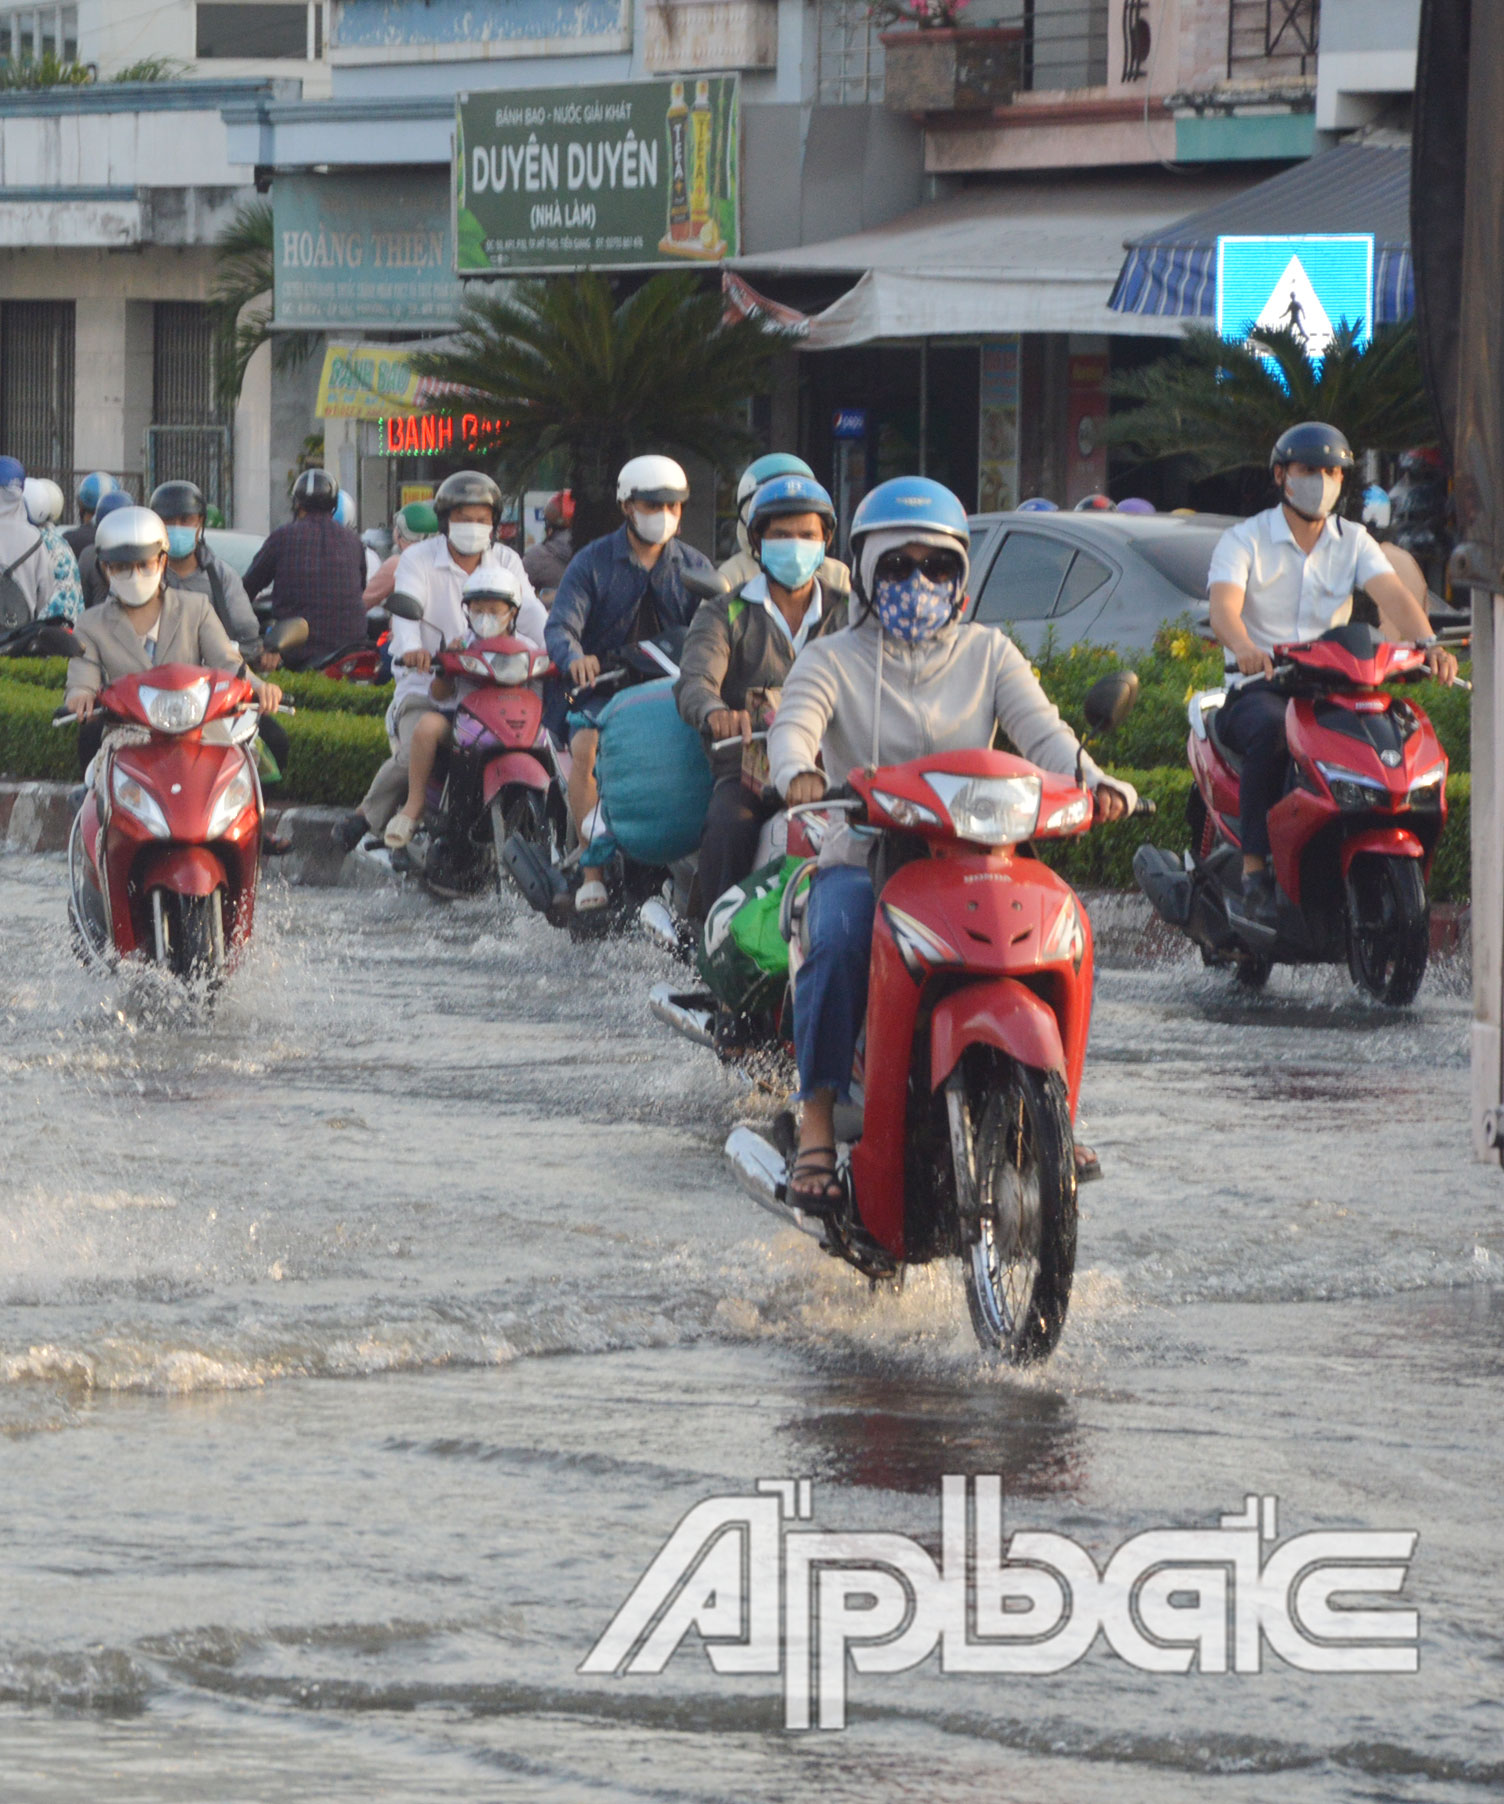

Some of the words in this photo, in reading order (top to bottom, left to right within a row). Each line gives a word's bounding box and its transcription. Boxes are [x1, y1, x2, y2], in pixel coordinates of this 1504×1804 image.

[496, 105, 523, 128] BÁNH
[524, 106, 546, 125] BAO
[553, 101, 583, 125] NƯỚC
[583, 99, 604, 123] GIẢI
[604, 99, 633, 122] KHÁT
[472, 132, 559, 193] DUYÊN
[567, 128, 658, 190] DUYÊN
[530, 198, 562, 231] (NHÀ
[564, 197, 596, 230] LÀM)
[371, 223, 445, 276] THIỆN
[963, 872, 1013, 884] HONDA
